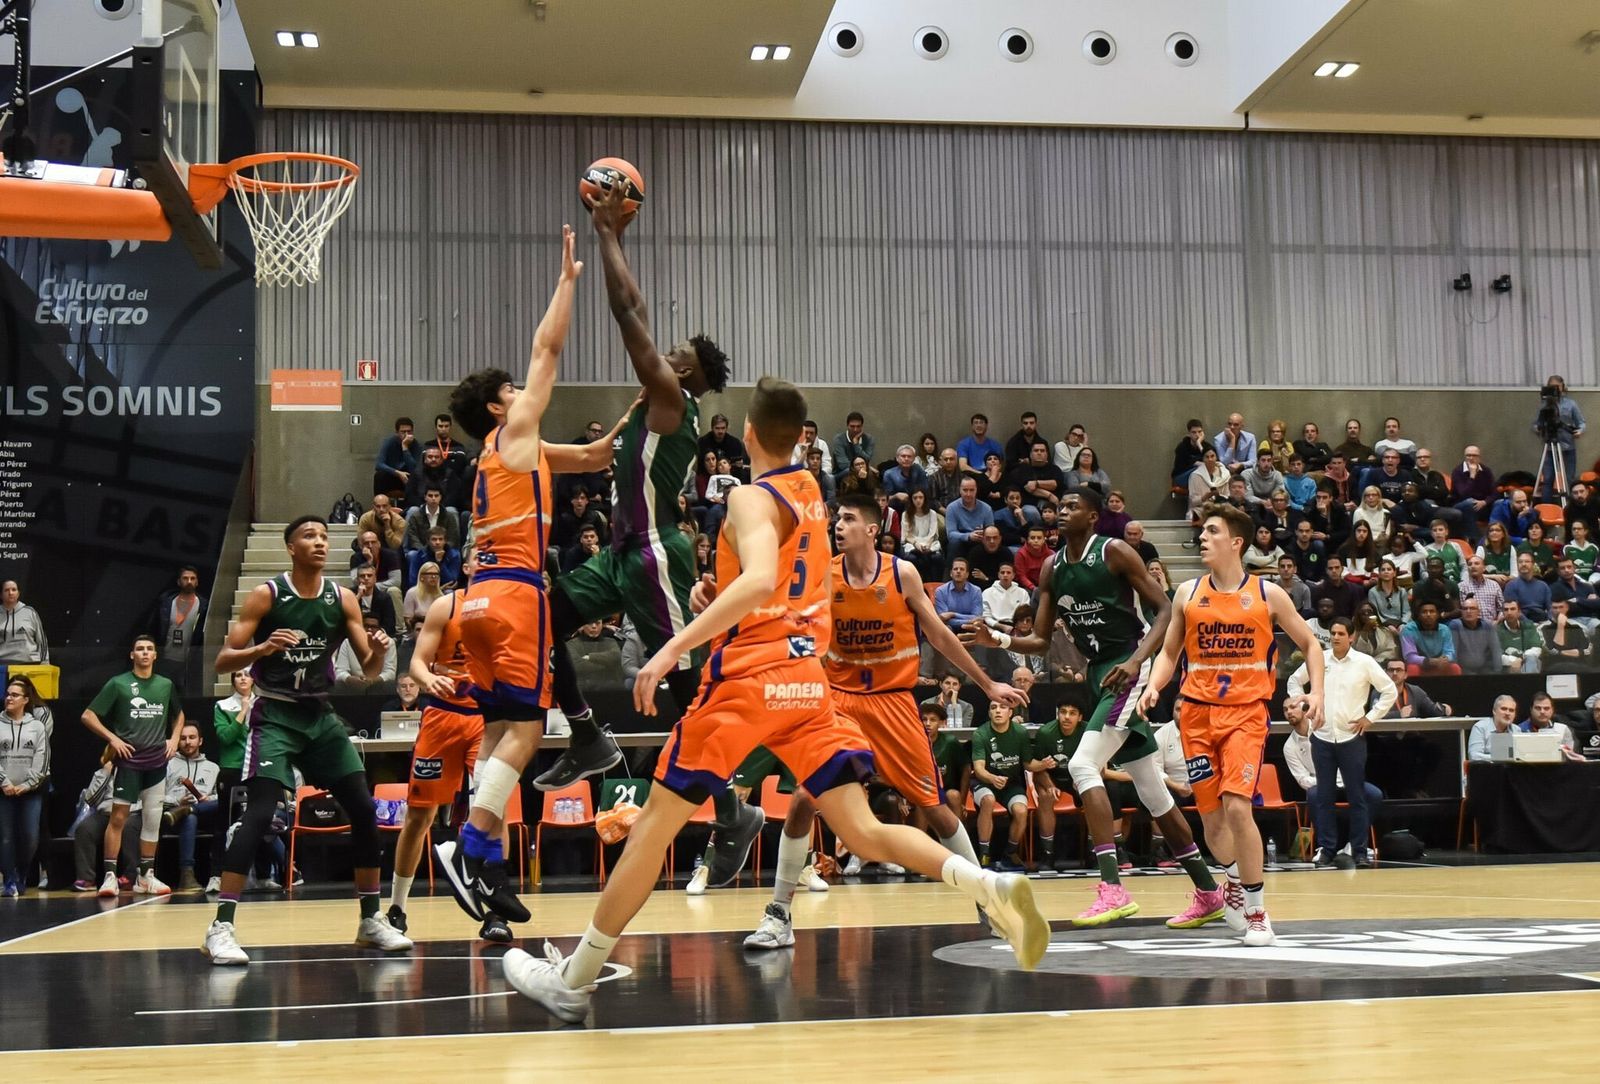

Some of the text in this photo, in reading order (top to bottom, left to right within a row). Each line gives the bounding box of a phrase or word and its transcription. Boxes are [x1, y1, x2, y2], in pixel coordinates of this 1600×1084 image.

[39, 277, 149, 301] Cultura del
[35, 301, 149, 325] Esfuerzo
[0, 386, 222, 416] LS SOMNIS
[3, 440, 32, 448] Navarro
[6, 460, 27, 468] Pérez
[2, 480, 33, 490] Triguero
[0, 490, 21, 498] Pérez
[3, 551, 28, 560] Segura
[835, 618, 882, 631] Cultura
[1197, 620, 1245, 635] Cultura
[305, 637, 327, 647] Unic
[836, 632, 895, 646] Esfuerzo
[1197, 635, 1255, 650] Esfuerzo
[764, 682, 824, 700] PAMESA
[1216, 673, 1232, 699] 7
[1187, 757, 1209, 770] LEVA
[614, 784, 637, 806] 21
